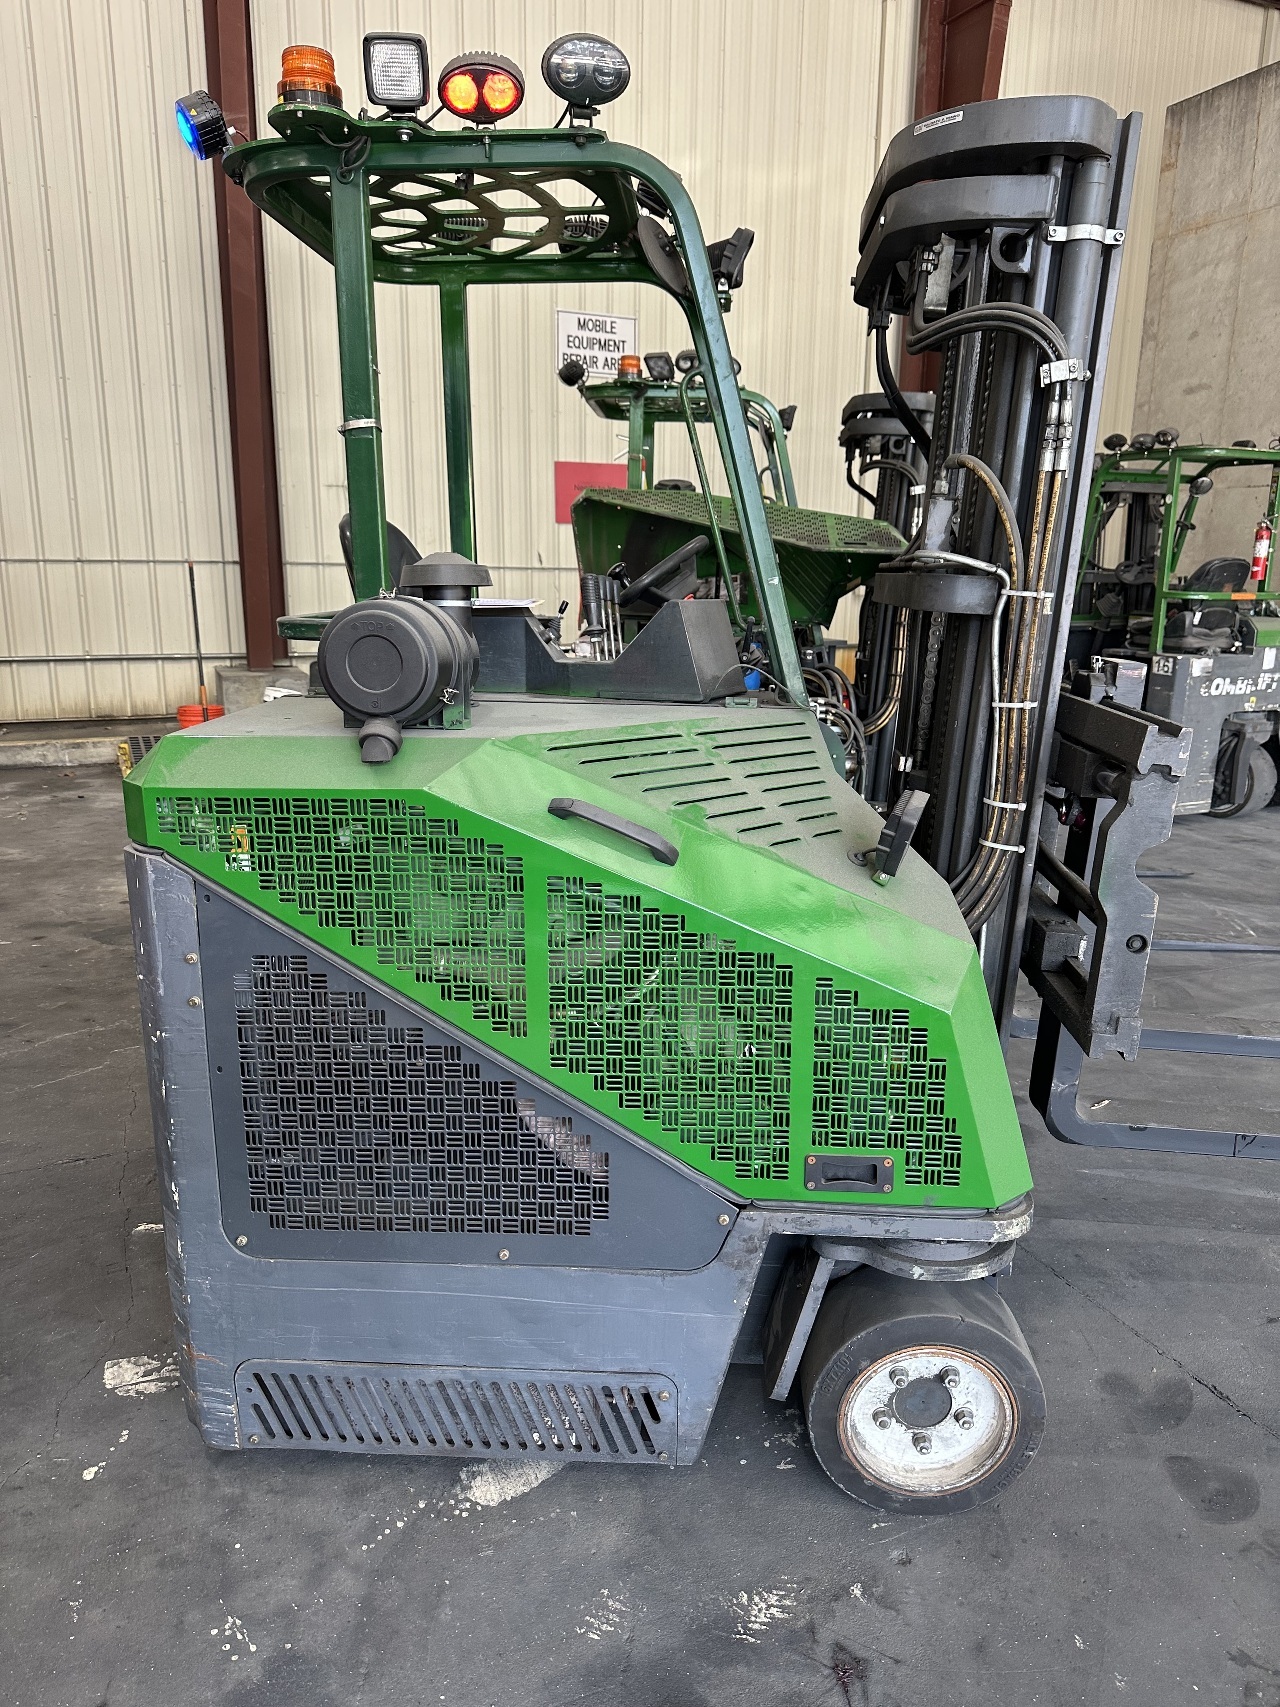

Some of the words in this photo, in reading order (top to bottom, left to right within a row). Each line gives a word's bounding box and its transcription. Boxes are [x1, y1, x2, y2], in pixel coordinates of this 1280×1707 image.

[577, 317, 617, 334] MOBILE
[567, 334, 627, 353] EQUIPMENT
[602, 357, 621, 370] ARE
[360, 620, 384, 631] TOP
[1155, 658, 1170, 673] 16
